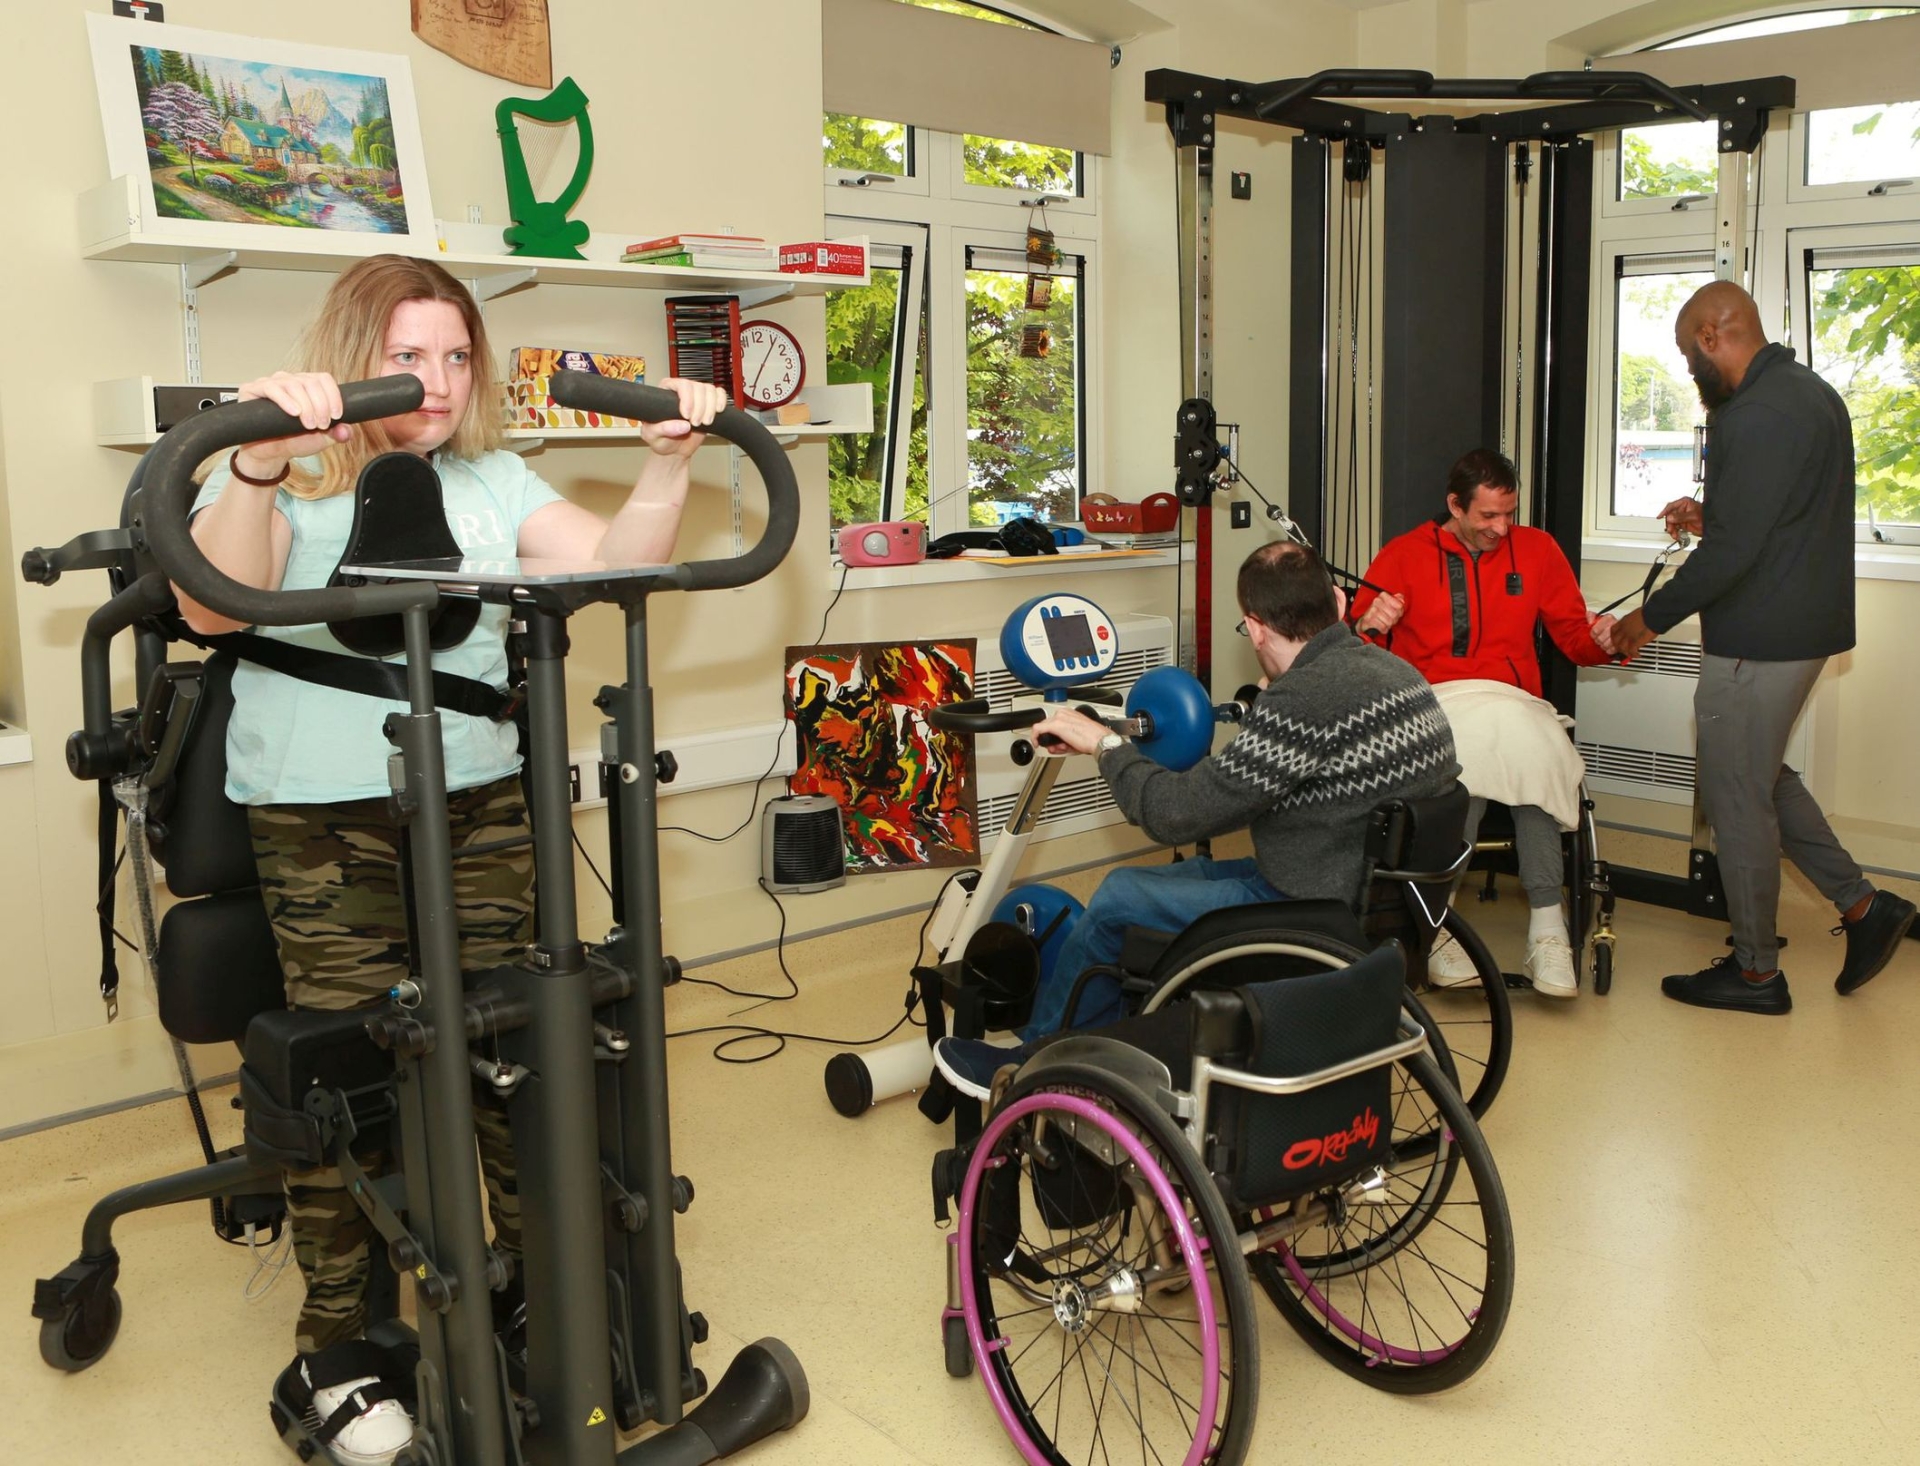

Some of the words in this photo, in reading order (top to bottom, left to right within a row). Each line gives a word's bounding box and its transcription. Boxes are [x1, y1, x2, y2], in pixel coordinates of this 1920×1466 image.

[1722, 240, 1730, 248] 16
[828, 252, 840, 264] 40
[752, 331, 763, 343] 12
[778, 344, 787, 356] 2
[785, 357, 793, 370] 3
[782, 372, 791, 384] 4
[762, 387, 771, 400] 6
[774, 383, 783, 396] 5
[1453, 591, 1467, 629] MAX
